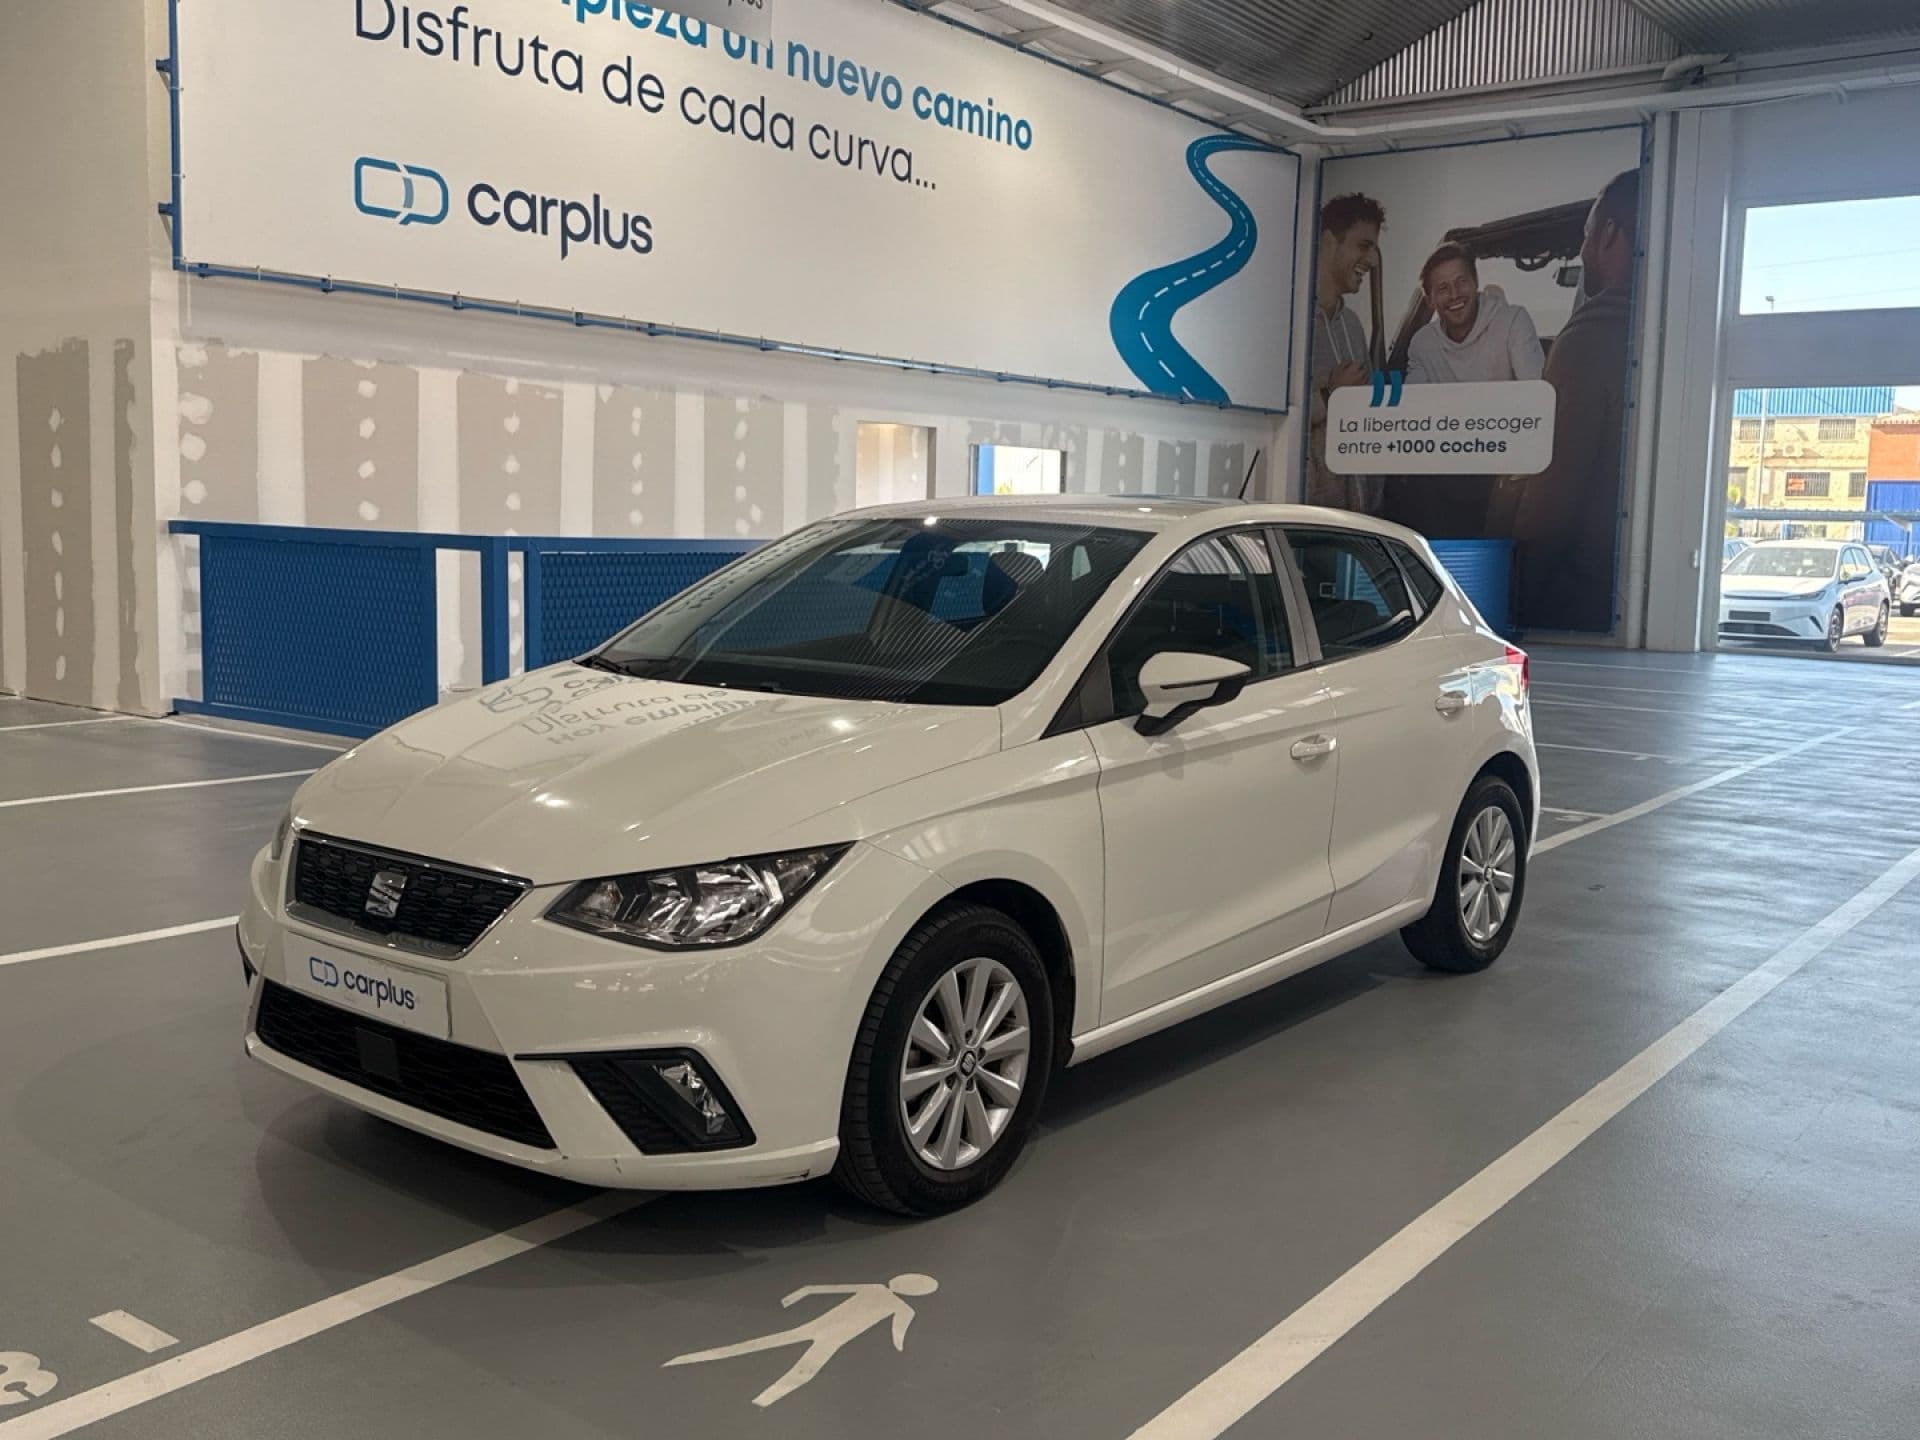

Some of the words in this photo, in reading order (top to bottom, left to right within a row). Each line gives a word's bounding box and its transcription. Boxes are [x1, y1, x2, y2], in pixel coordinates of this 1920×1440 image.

[355, 0, 584, 94] Disfruta
[602, 55, 665, 114] de
[679, 86, 795, 152] cada
[808, 123, 936, 191] curva...
[787, 40, 903, 111] nuevo
[912, 85, 1033, 151] camino
[467, 182, 653, 261] carplus
[1337, 441, 1383, 455] entre
[1386, 439, 1436, 454] +1000
[1439, 438, 1508, 454] coches
[1339, 418, 1358, 433] La
[1363, 416, 1432, 433] libertad
[1436, 416, 1461, 432] de
[1464, 416, 1542, 434] escoger
[343, 970, 416, 1011] carplus
